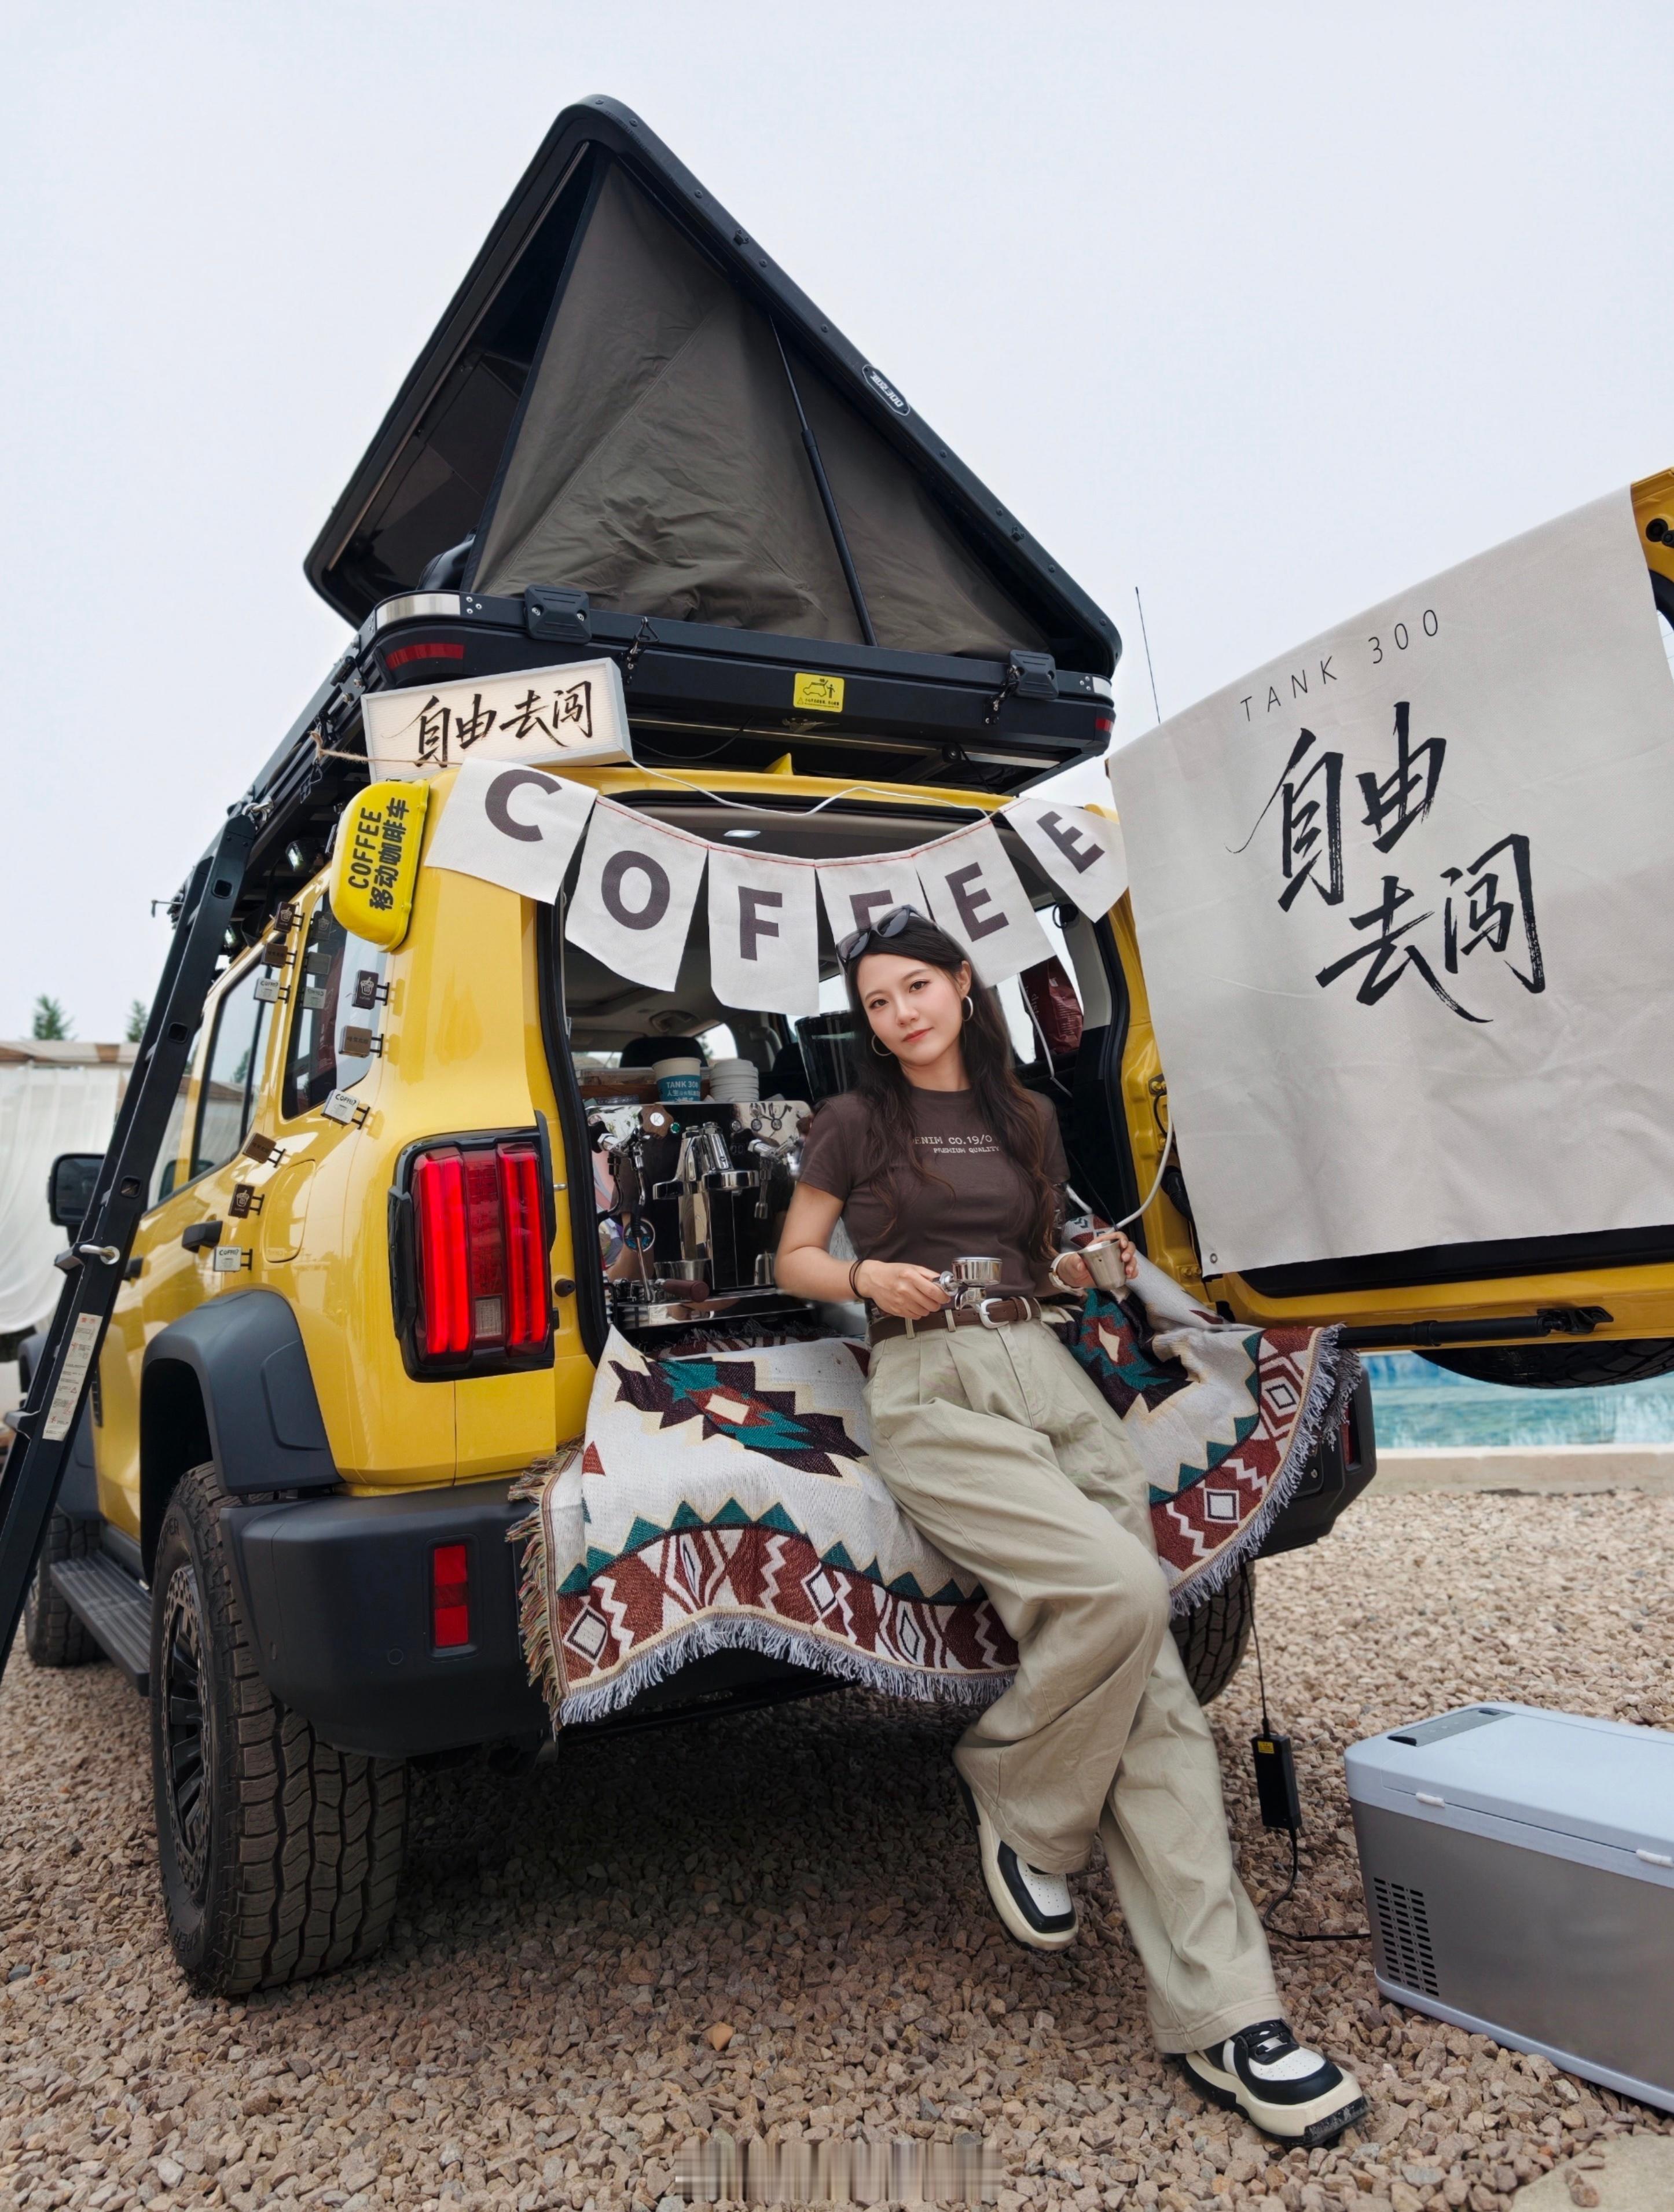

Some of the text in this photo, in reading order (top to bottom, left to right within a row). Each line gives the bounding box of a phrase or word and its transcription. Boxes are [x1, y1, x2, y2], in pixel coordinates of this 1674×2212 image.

[1240, 609, 1438, 722] TANK 300
[381, 681, 593, 767] 自由去闯
[348, 807, 382, 889] COFFEE
[369, 797, 410, 911] 移动咖啡车
[1224, 701, 1447, 912] 自由
[1316, 833, 1545, 1023] 去闯
[912, 1136, 943, 1144] ENIM
